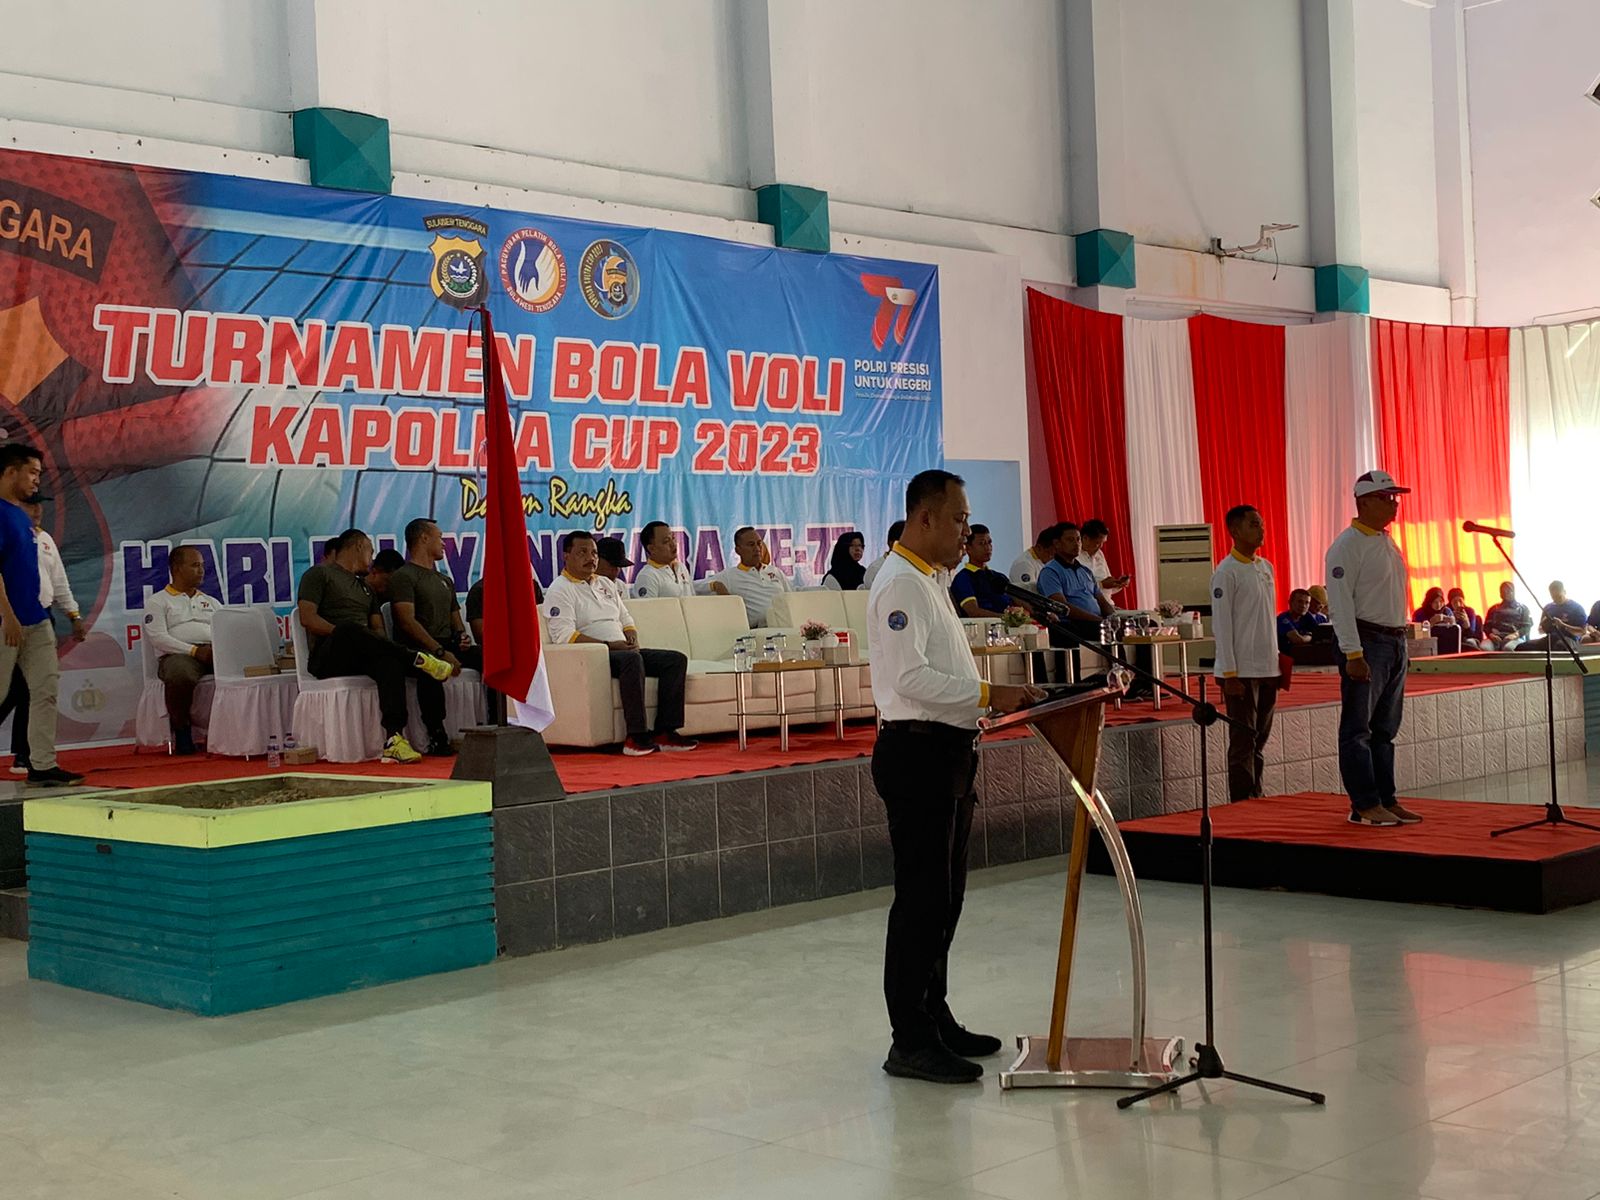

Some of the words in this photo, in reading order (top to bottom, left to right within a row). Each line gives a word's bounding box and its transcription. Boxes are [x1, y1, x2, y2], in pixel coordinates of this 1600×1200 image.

[95, 305, 536, 401] TURNAMEN
[550, 337, 712, 409] BOLA
[726, 349, 846, 416] VOLI
[854, 359, 887, 373] POLRI
[890, 361, 929, 376] PRESISI
[854, 375, 893, 389] UNTUK
[895, 378, 932, 391] NEGERI
[246, 403, 555, 473] KAPOLA
[570, 413, 681, 474] CUP
[691, 419, 821, 476] 2023
[461, 477, 543, 520] Dam
[550, 475, 633, 530] Rangka
